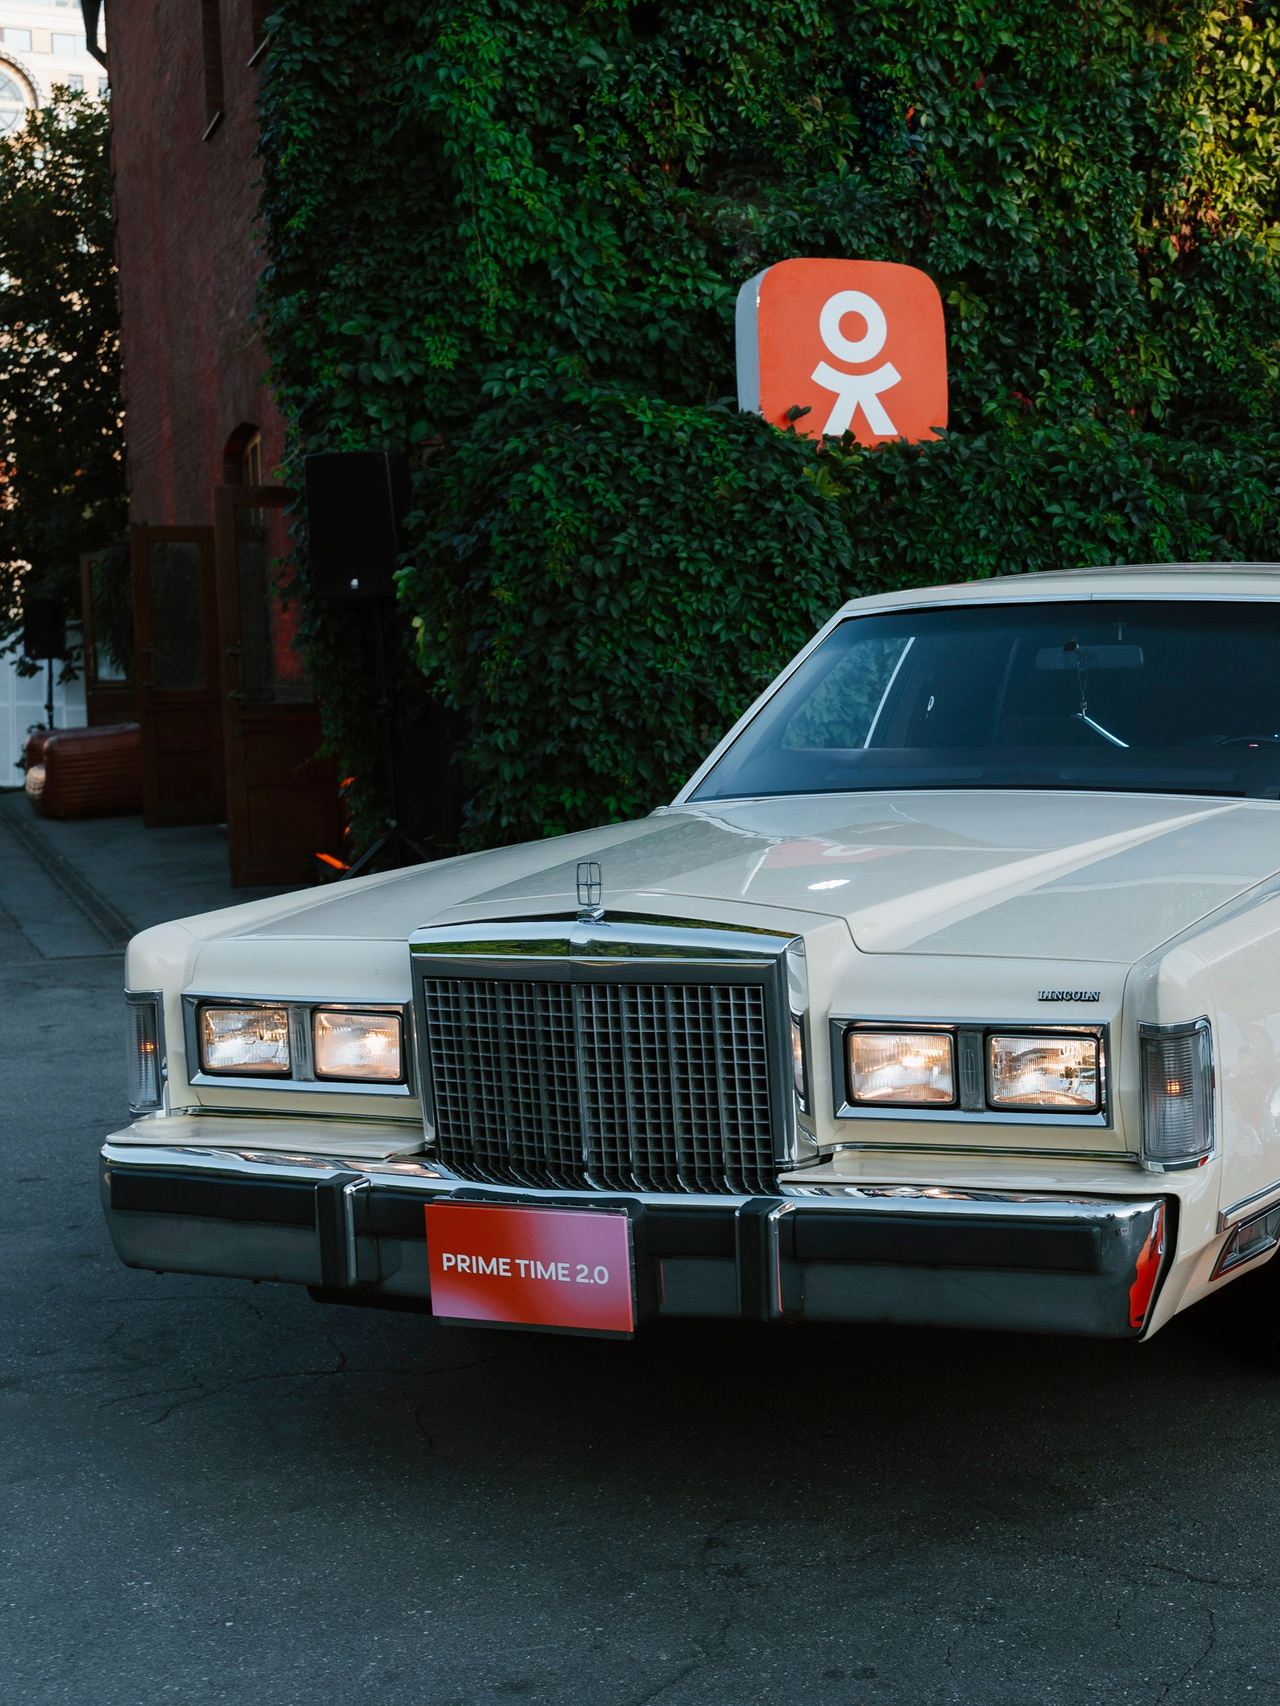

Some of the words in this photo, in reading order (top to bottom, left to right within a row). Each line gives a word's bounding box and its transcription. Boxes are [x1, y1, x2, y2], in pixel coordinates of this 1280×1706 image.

[1038, 990, 1101, 1002] LINCOLN
[442, 1253, 512, 1277] PRIME
[515, 1259, 571, 1282] TIME
[575, 1264, 609, 1285] 2.0
